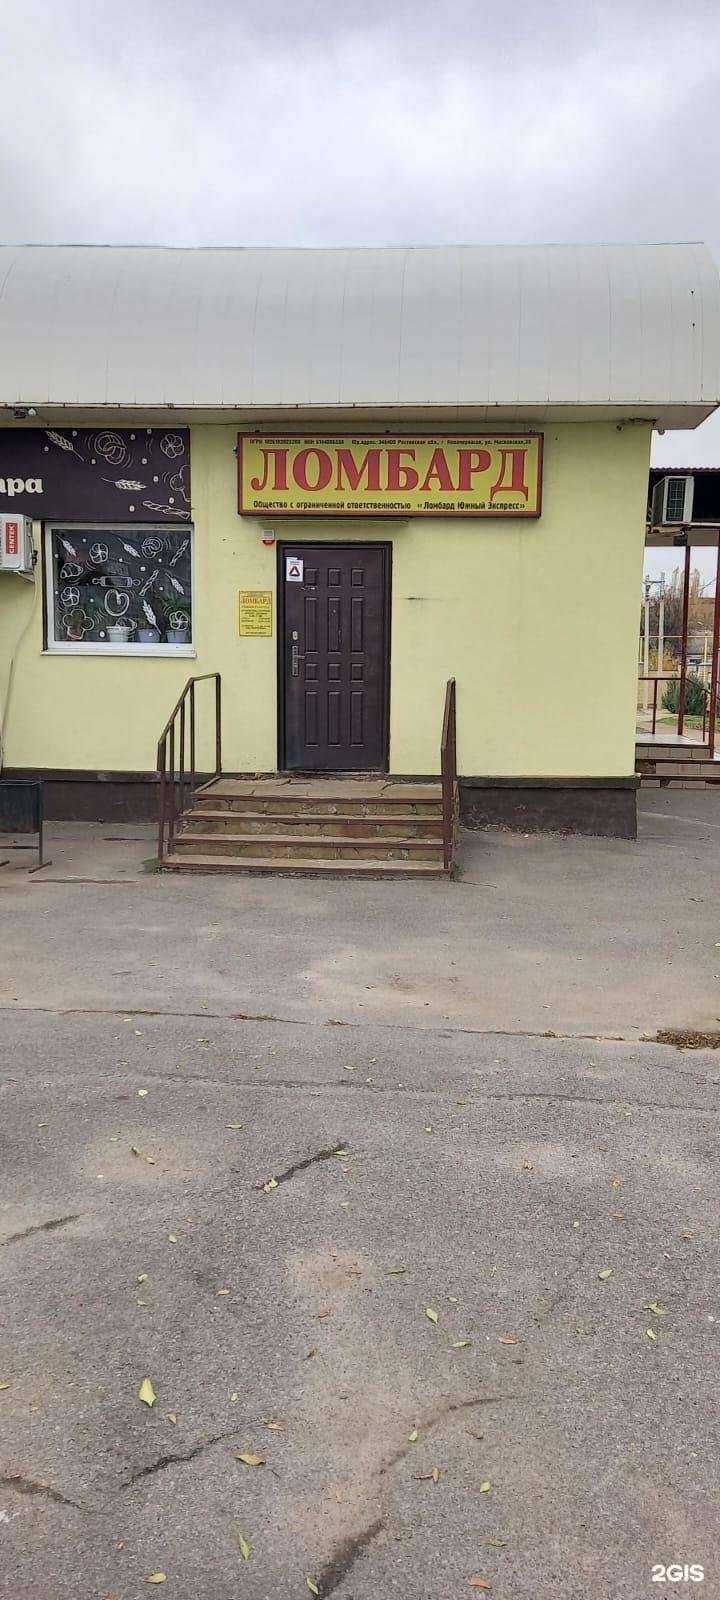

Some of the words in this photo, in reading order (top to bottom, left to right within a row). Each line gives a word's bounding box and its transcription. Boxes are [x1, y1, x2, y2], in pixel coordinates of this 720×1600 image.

[251, 448, 529, 502] ЛОМБАРД
[0, 477, 44, 497] ра
[253, 500, 288, 509] Общество
[296, 501, 345, 509] ограниченной
[457, 501, 486, 510] Южный
[488, 502, 526, 510] Экспресс»
